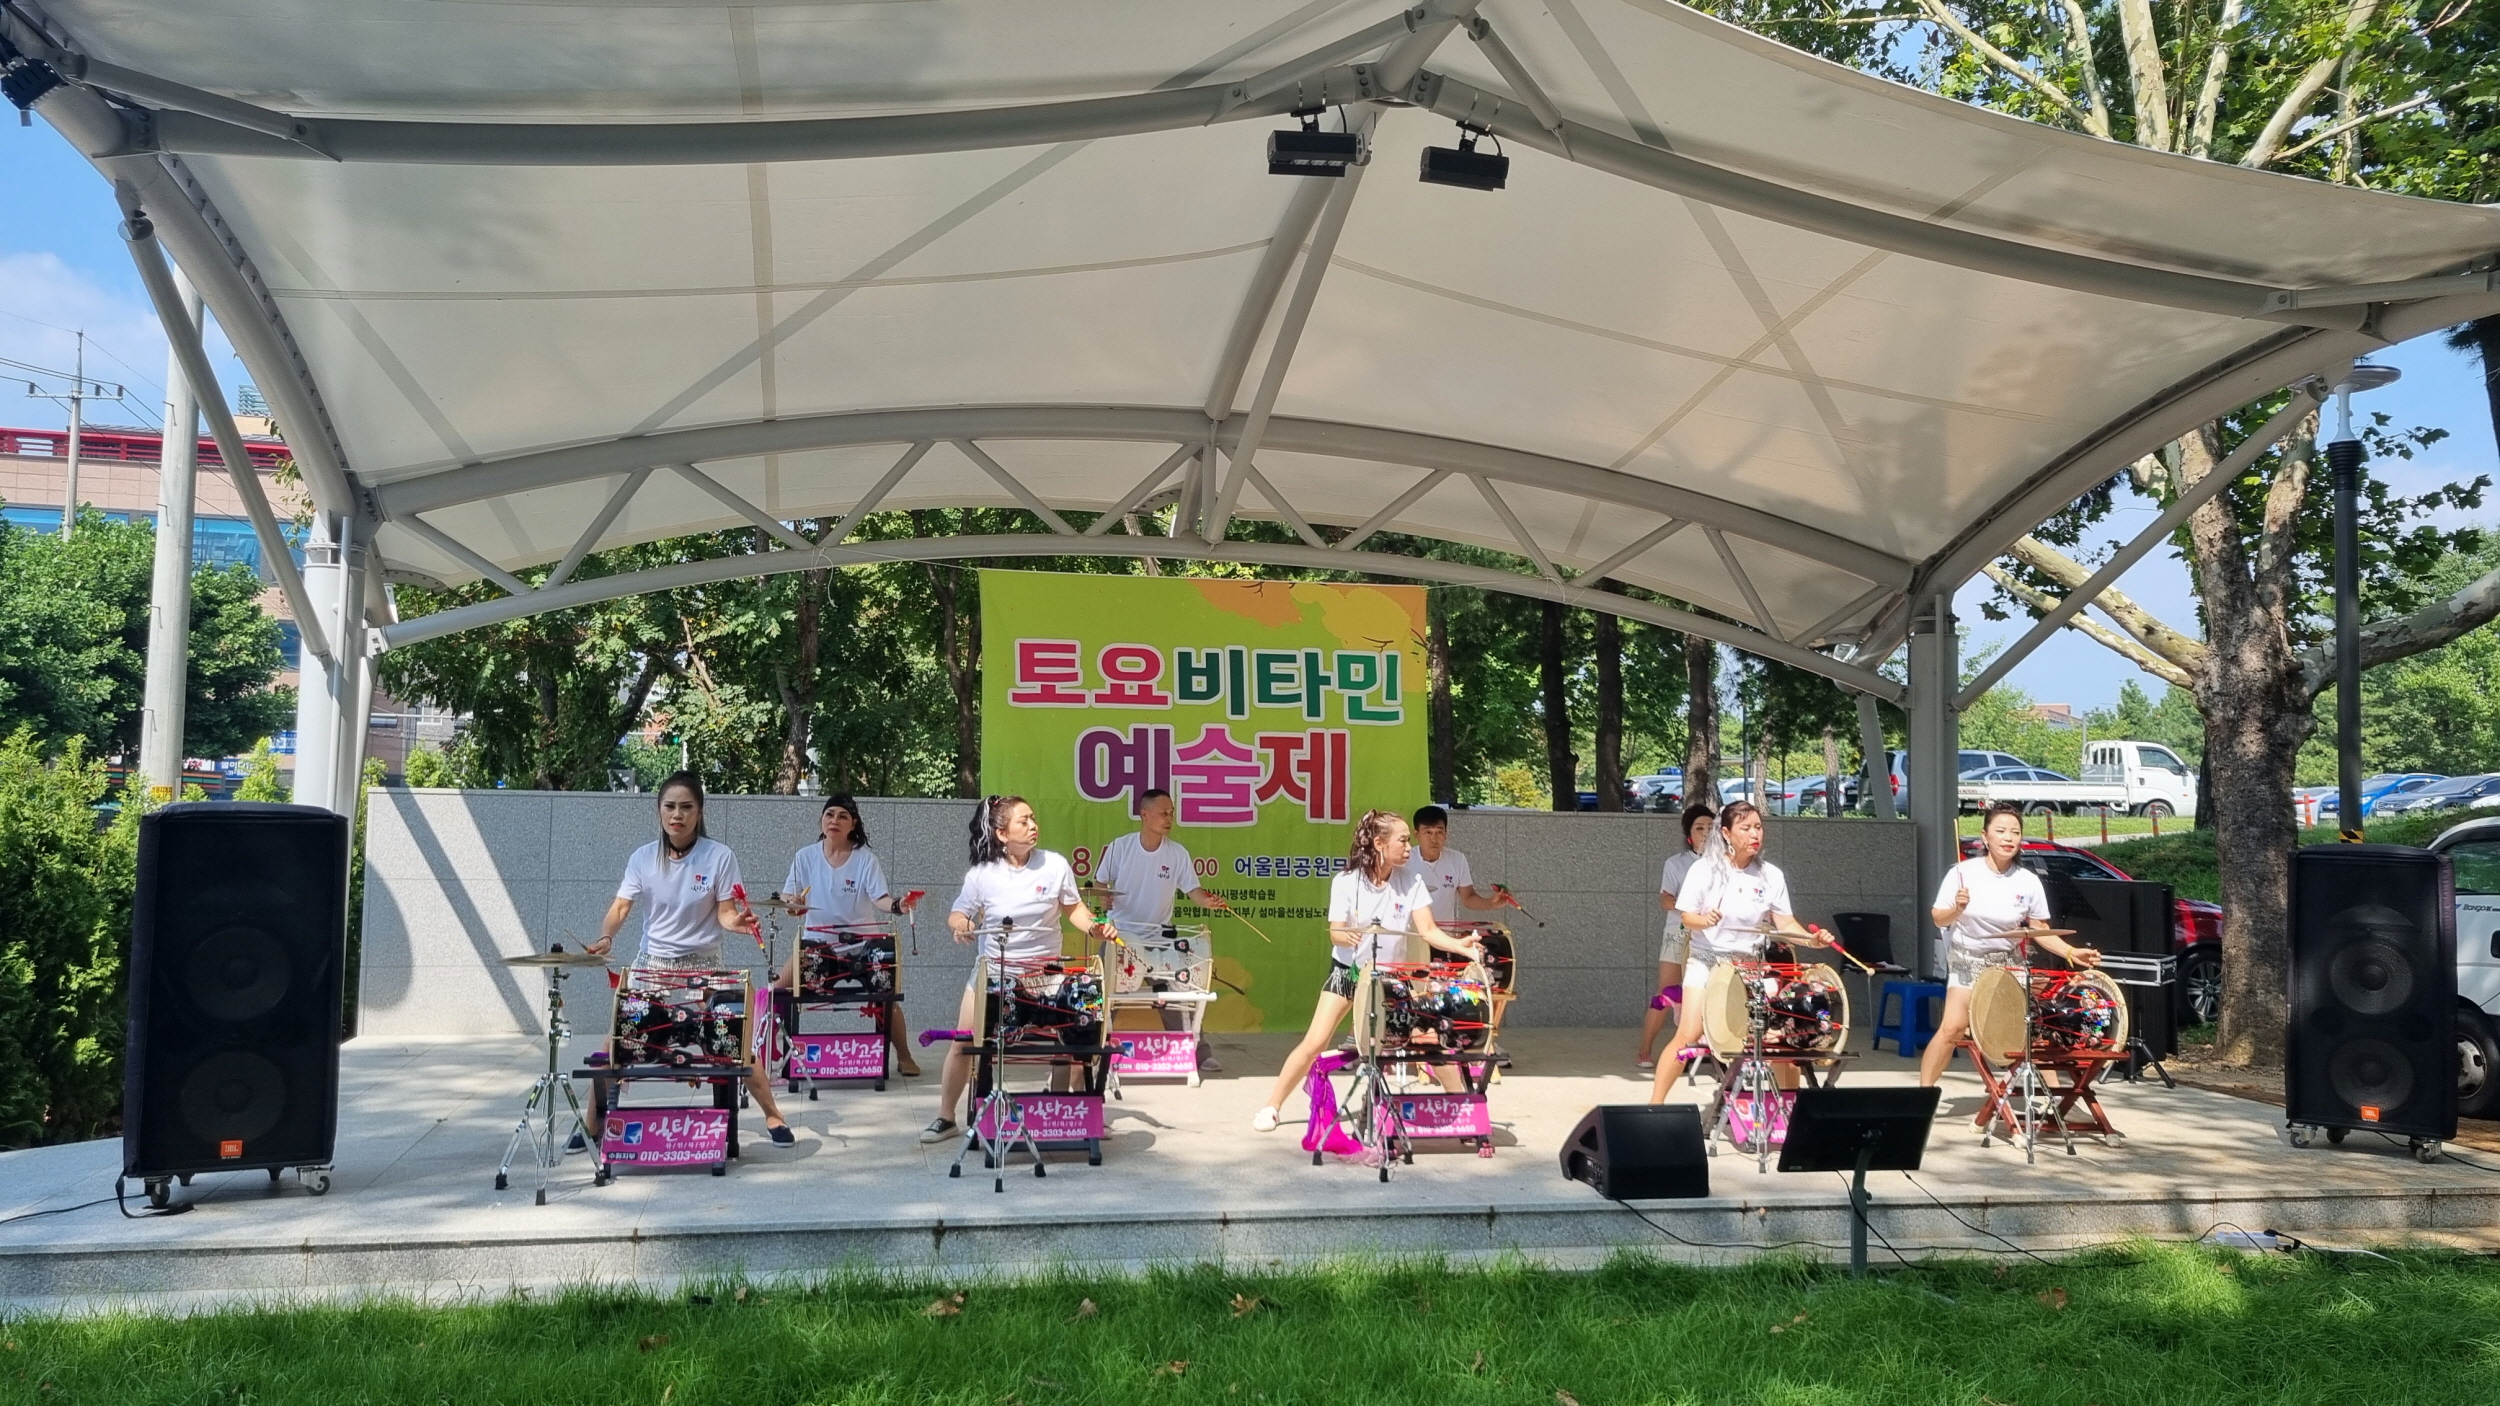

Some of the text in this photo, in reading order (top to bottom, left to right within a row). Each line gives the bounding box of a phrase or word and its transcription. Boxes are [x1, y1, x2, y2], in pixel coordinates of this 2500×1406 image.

[1010, 640, 1403, 724] 토요비타민
[1077, 725, 1349, 825] 예술제
[820, 1065, 883, 1075] 010-3303-6650
[648, 1114, 728, 1142] 일타고수
[639, 1149, 721, 1162] 010-3303-6650
